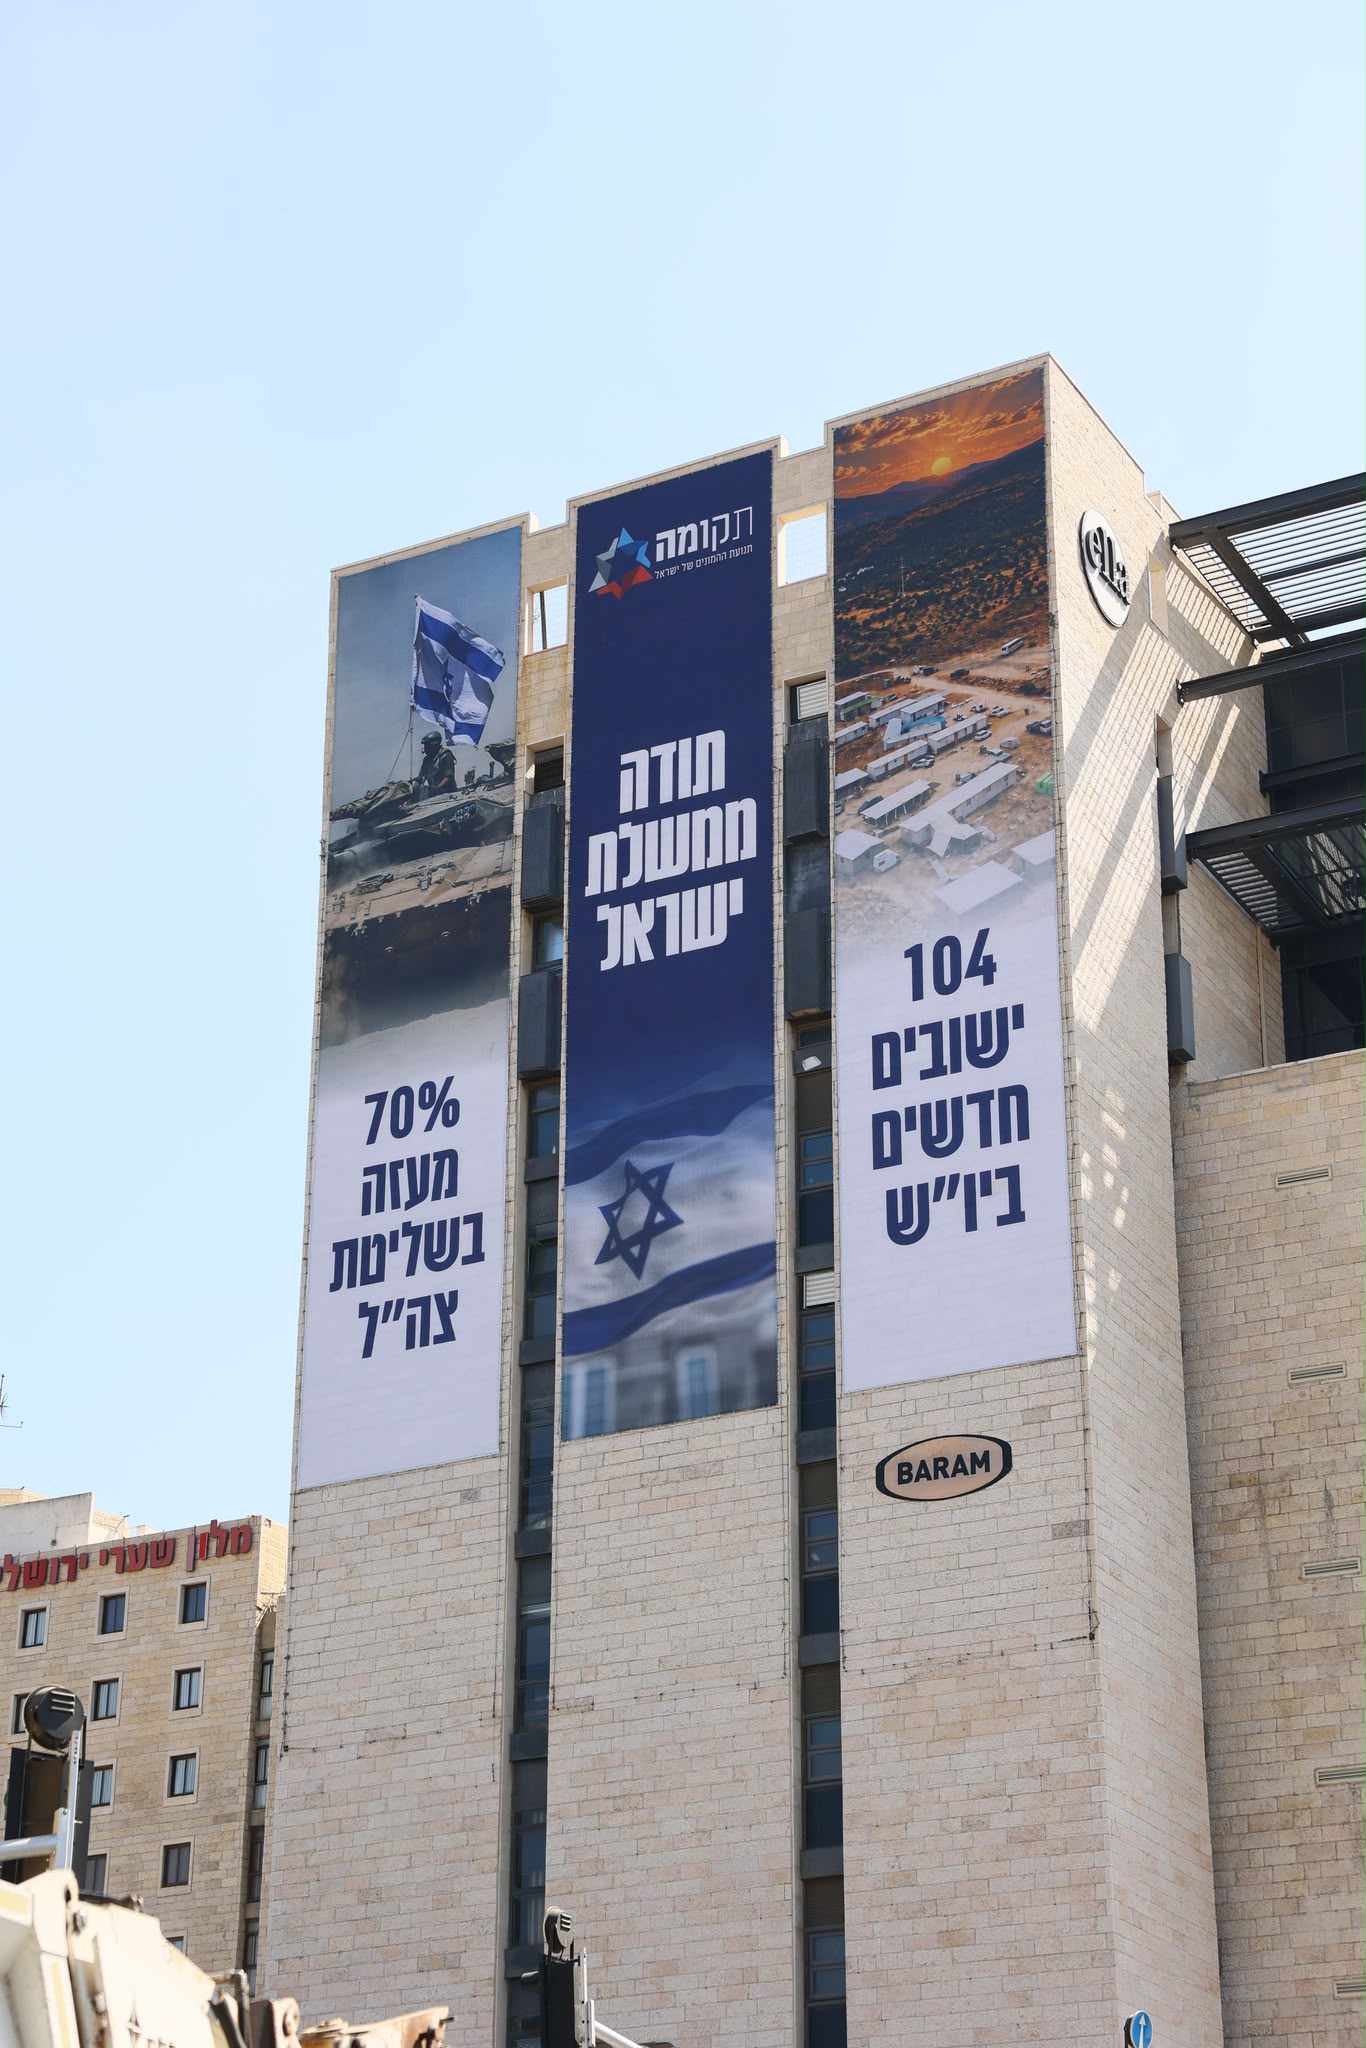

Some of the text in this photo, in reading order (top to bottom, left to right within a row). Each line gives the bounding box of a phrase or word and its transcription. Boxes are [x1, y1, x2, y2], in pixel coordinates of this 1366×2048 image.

[655, 506, 753, 563] תקומה
[655, 545, 752, 579] תנועת ההמונים של ישראל
[619, 729, 726, 815] תודה
[584, 797, 757, 898] ממשלת
[596, 877, 744, 972] ישראל
[904, 927, 998, 1002] 104
[871, 1003, 1025, 1091] ישובים
[364, 1075, 461, 1146] 70%
[871, 1084, 1031, 1170] חדשים
[361, 1148, 459, 1217] מעזה
[329, 1211, 485, 1293] בשליטת
[897, 1450, 991, 1486] BARAM
[0, 1519, 252, 1592] מלון שערי ירושל
